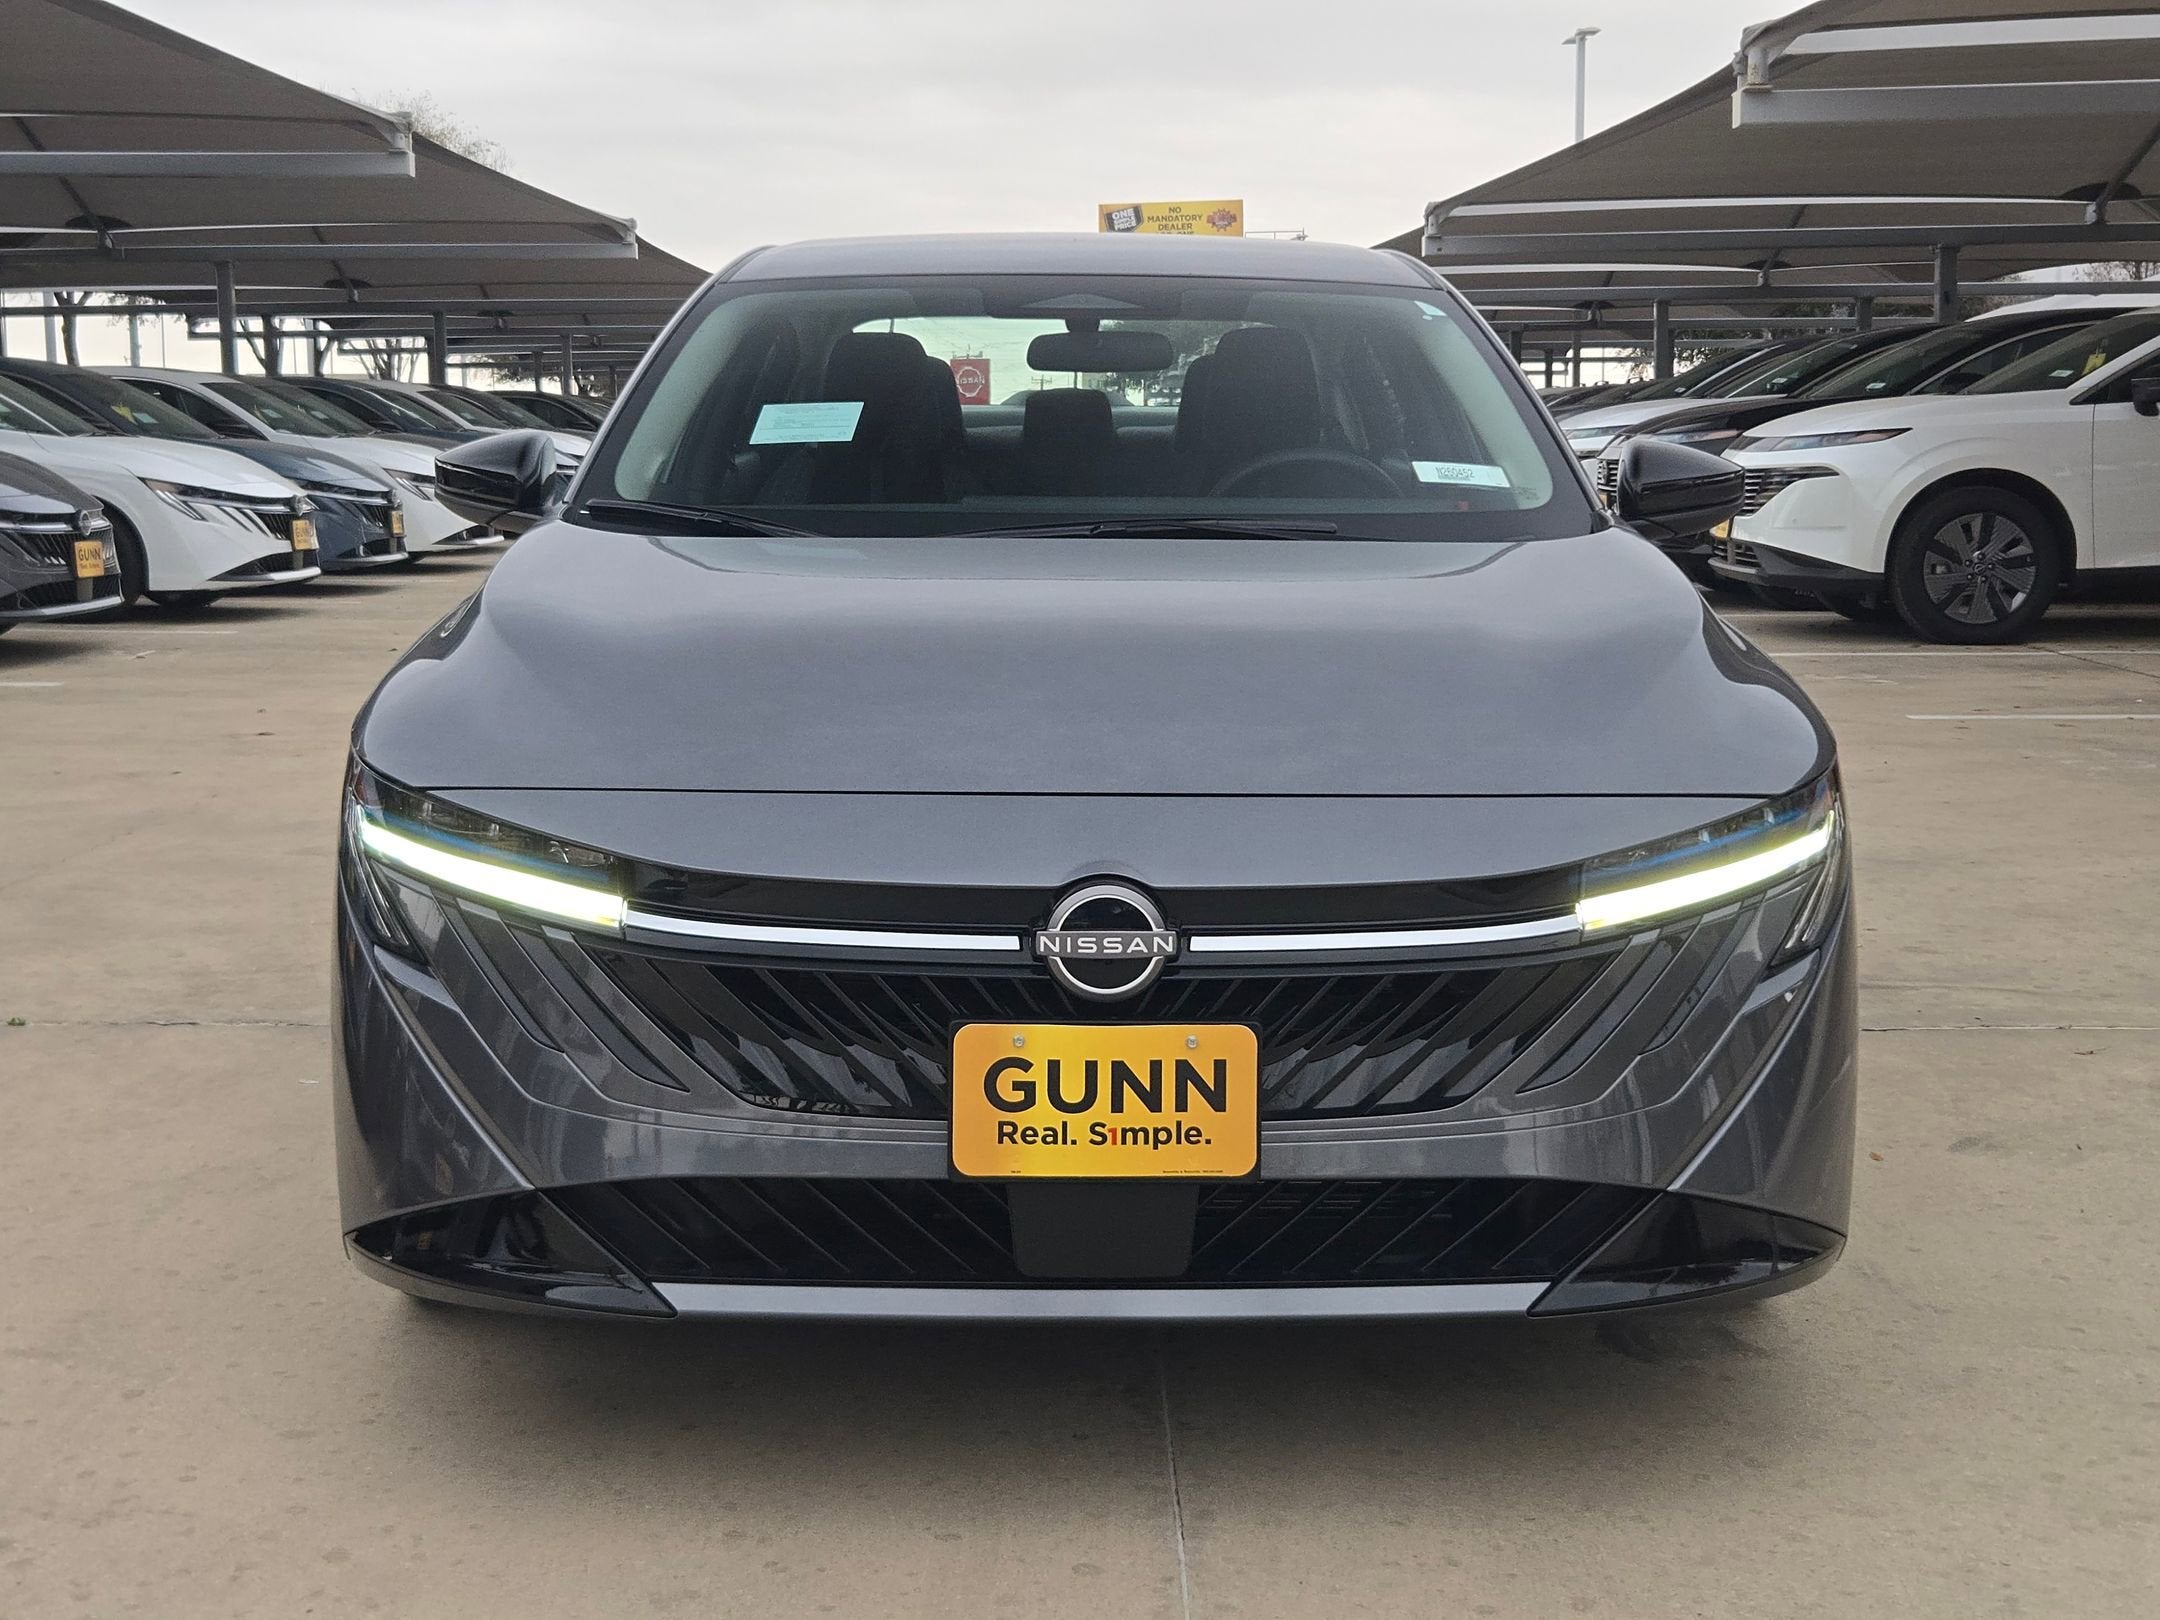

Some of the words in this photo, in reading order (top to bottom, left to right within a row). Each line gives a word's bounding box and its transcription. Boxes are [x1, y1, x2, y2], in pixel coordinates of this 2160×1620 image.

[1112, 208, 1135, 220] ONE
[1168, 206, 1182, 214] NO
[1147, 214, 1203, 223] MANDATORY
[1158, 223, 1193, 231] DEALER
[79, 548, 101, 561] GUNN
[1040, 935, 1173, 954] NISSAN
[983, 1056, 1227, 1114] GUNN
[997, 1120, 1077, 1145] Real.
